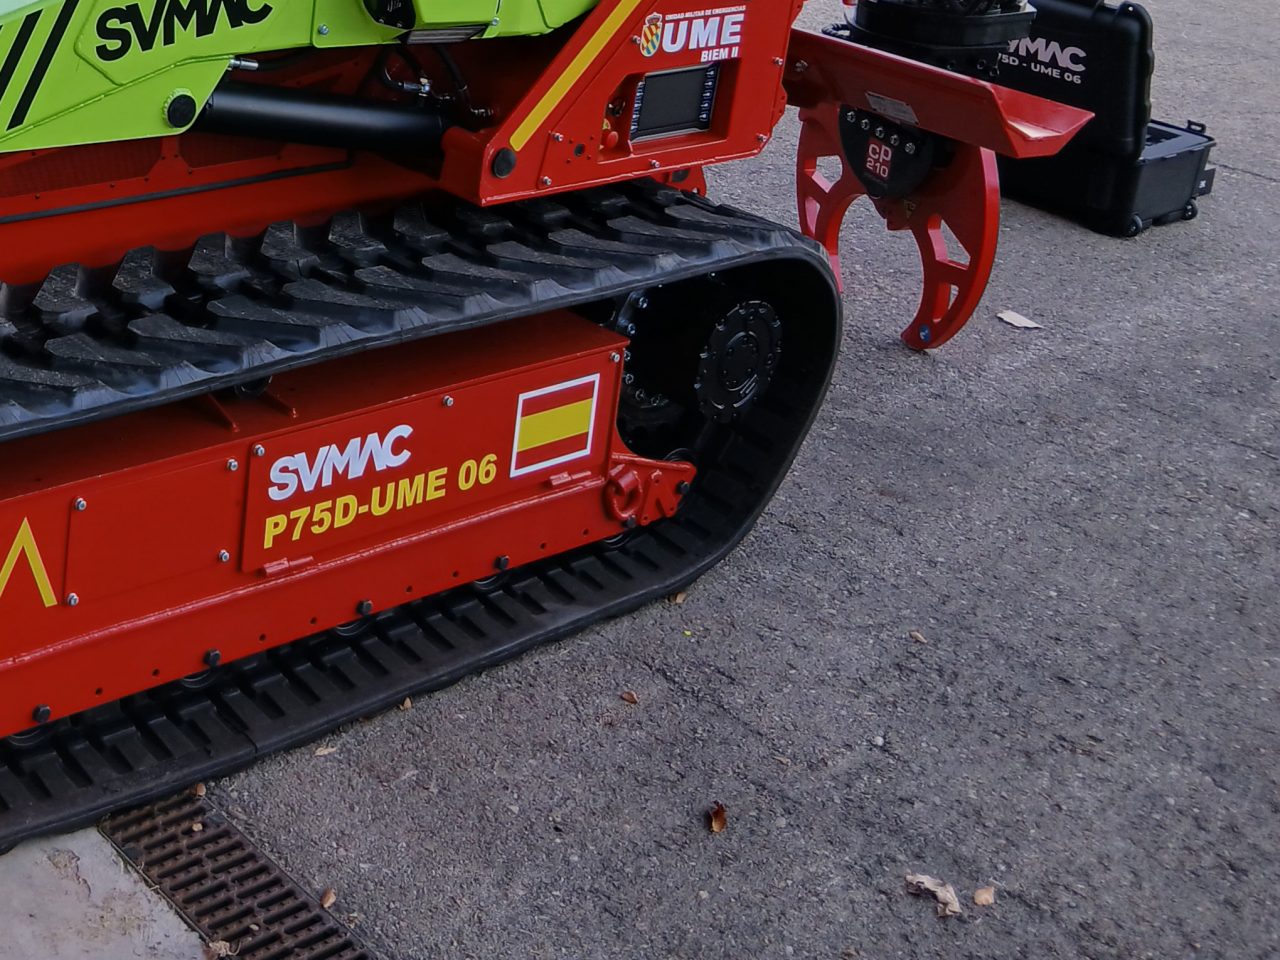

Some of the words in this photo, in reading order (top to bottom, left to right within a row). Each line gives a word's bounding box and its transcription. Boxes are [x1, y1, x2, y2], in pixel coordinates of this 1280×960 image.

[662, 14, 744, 52] UME
[700, 48, 729, 62] BIEM
[731, 46, 739, 58] II
[1030, 62, 1061, 78] UME
[1063, 72, 1082, 84] 06
[866, 157, 889, 178] 210
[268, 424, 414, 500] SVMAC
[263, 467, 448, 549] P75D-UME
[458, 453, 497, 491] 06
